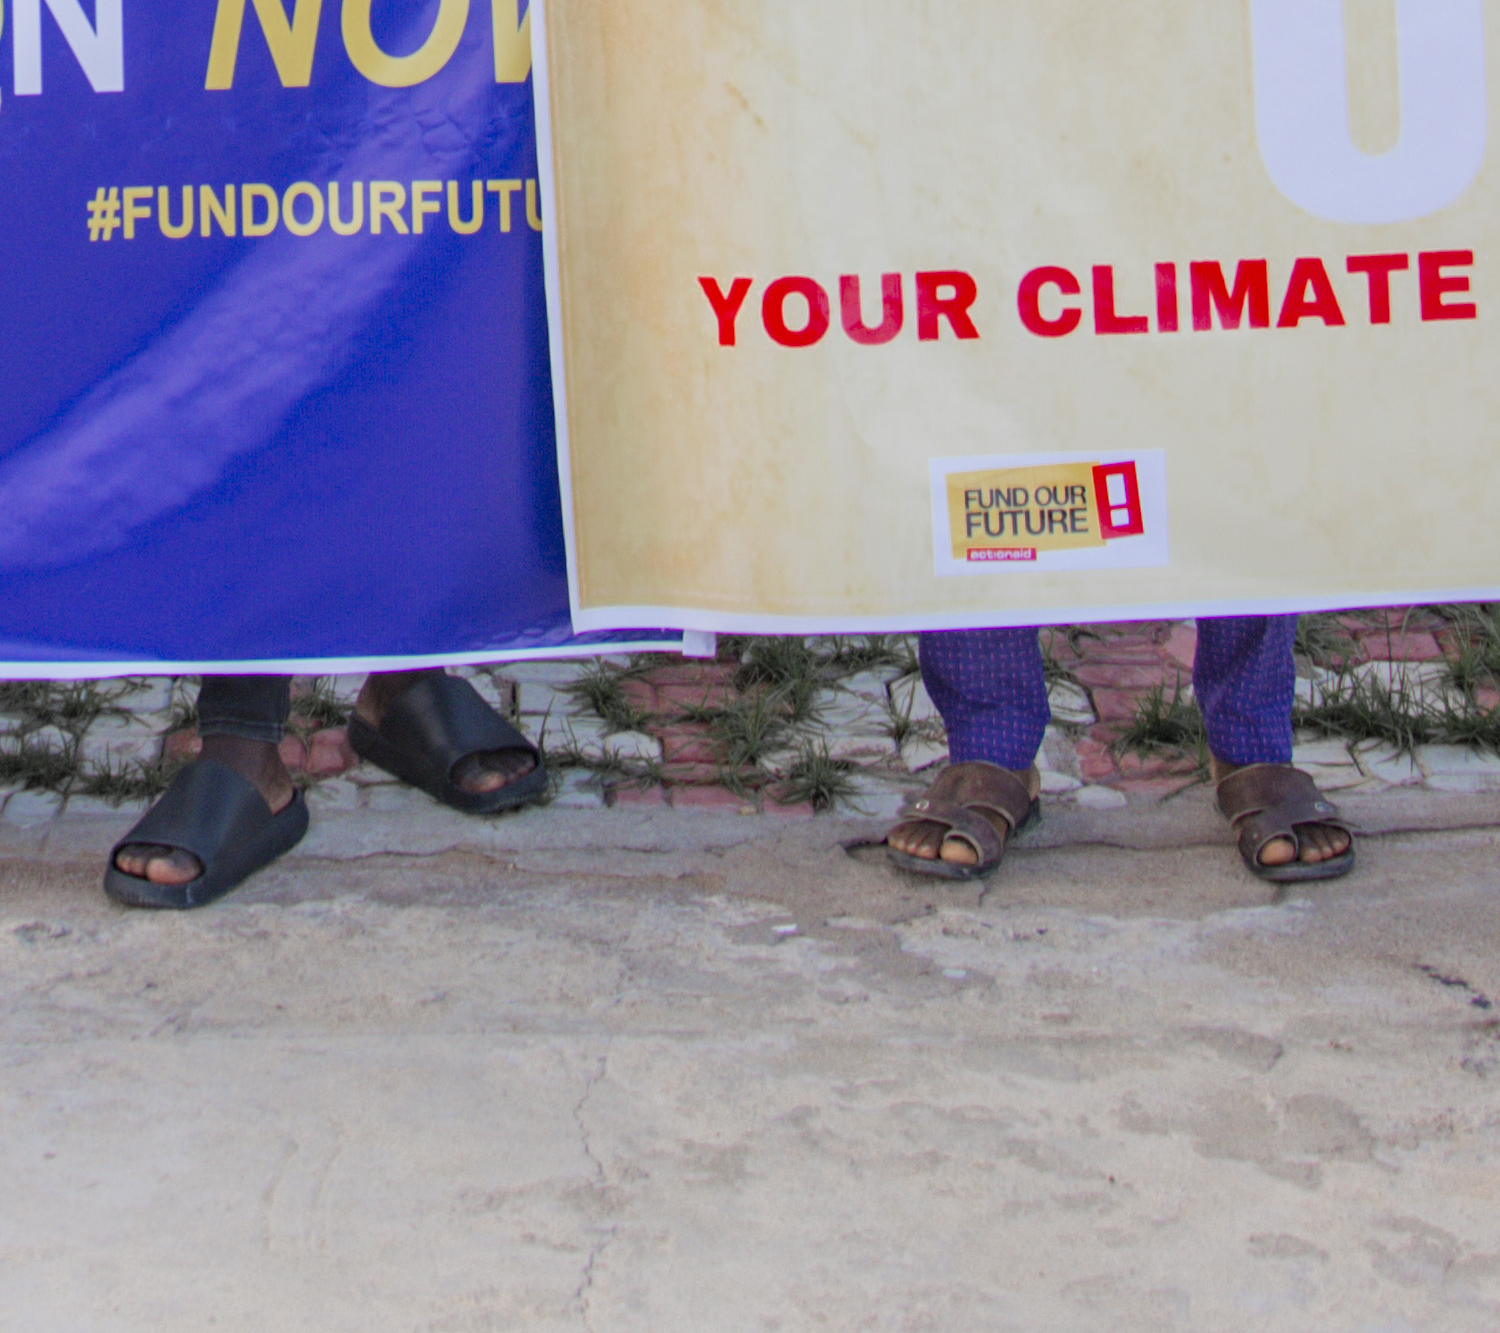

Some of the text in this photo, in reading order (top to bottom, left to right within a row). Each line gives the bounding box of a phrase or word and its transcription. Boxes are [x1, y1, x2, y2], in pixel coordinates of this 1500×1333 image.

[86, 178, 543, 242] #FUNDOURFUTU
[698, 269, 981, 348] YOUR
[1015, 249, 1479, 338] CLIMATE
[964, 485, 1087, 509] FUND OUR
[965, 507, 1089, 538] FUTURE
